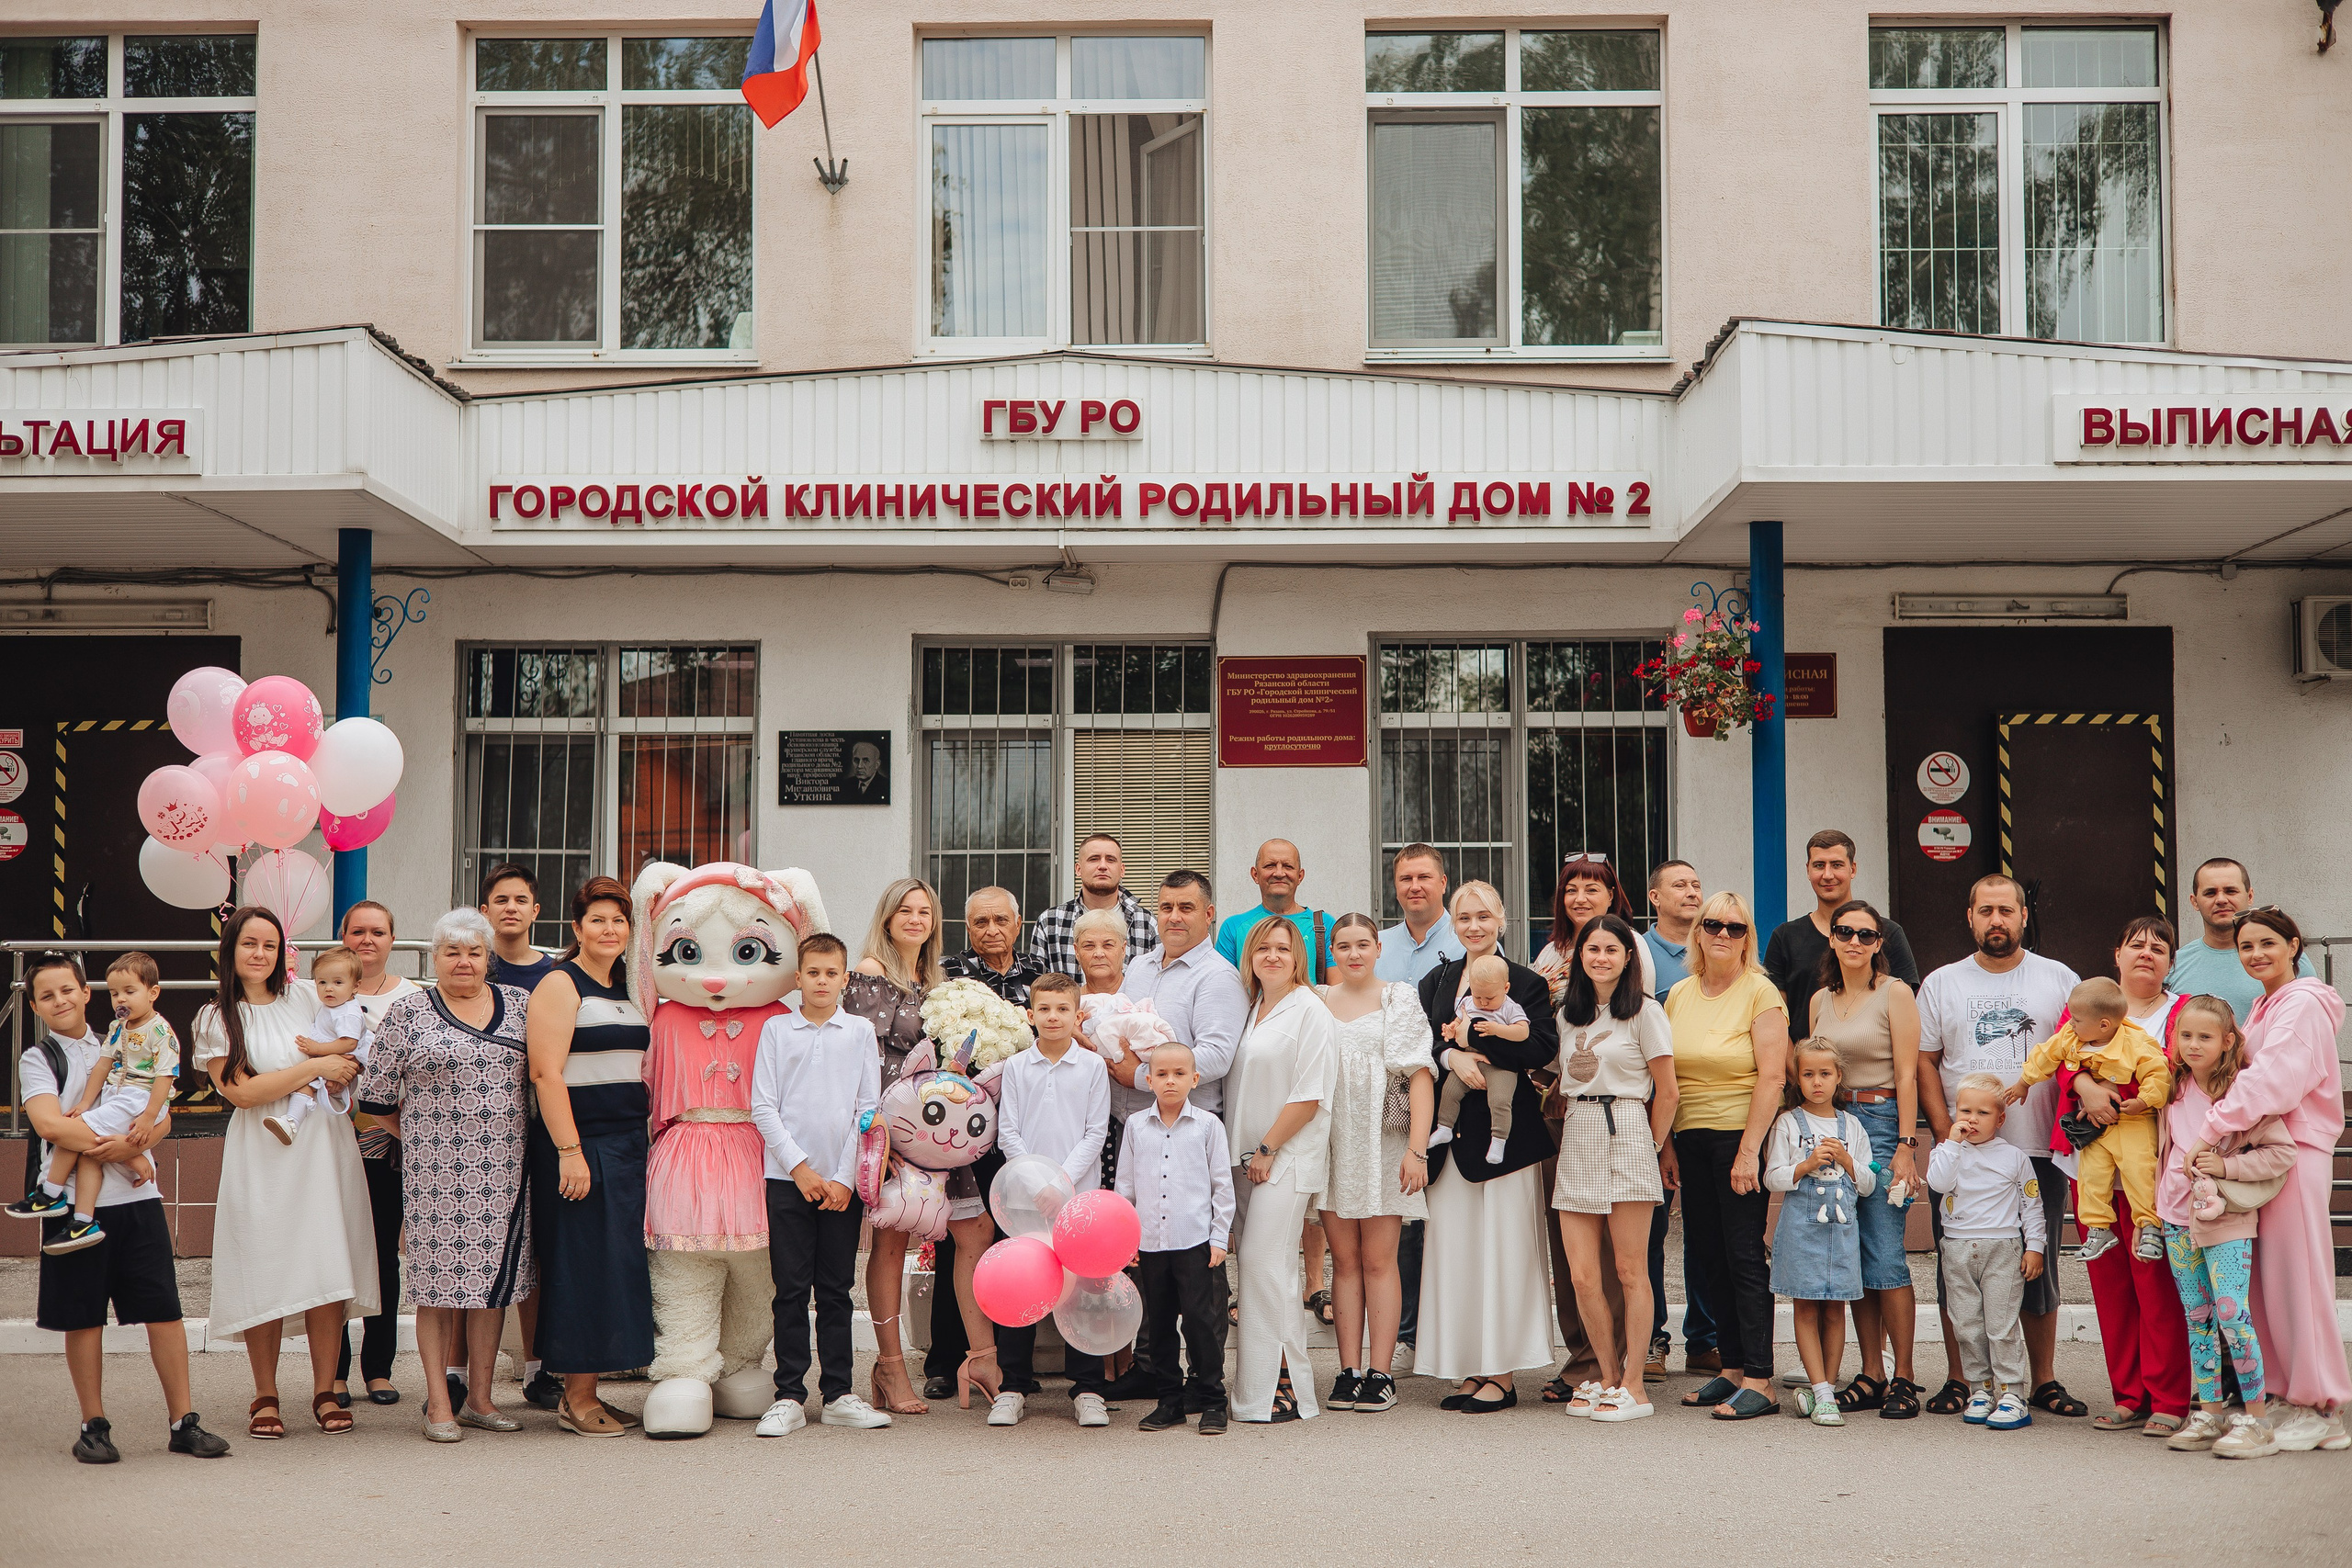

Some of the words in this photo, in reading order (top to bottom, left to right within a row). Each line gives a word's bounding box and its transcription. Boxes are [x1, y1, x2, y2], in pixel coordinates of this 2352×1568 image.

[983, 400, 1066, 434] ГБУ
[1080, 400, 1141, 434] РО
[2084, 407, 2352, 446] ВЫПИСНА
[489, 476, 768, 525] ГОРОДСКОЙ
[785, 474, 1122, 518] КЛИНИЧЕСКИЙ
[1139, 472, 1434, 523] РОДИЛЬНЫЙ
[1448, 481, 1551, 522] ДОМ
[1567, 481, 1614, 515] №
[1627, 481, 1651, 514] 2
[1227, 672, 1285, 681] Министерство
[1286, 672, 1357, 681] здравоохранения
[1257, 688, 1303, 696] «Городской
[1304, 687, 1358, 695] клинический
[1250, 696, 1296, 705] родильный
[1257, 735, 1285, 743] работы
[796, 777, 829, 786] Виктора
[786, 784, 840, 793] Михайловича
[794, 792, 832, 801] Уткина
[1971, 999, 2008, 1010] LEGEN
[1971, 1058, 2013, 1070] BEACH
